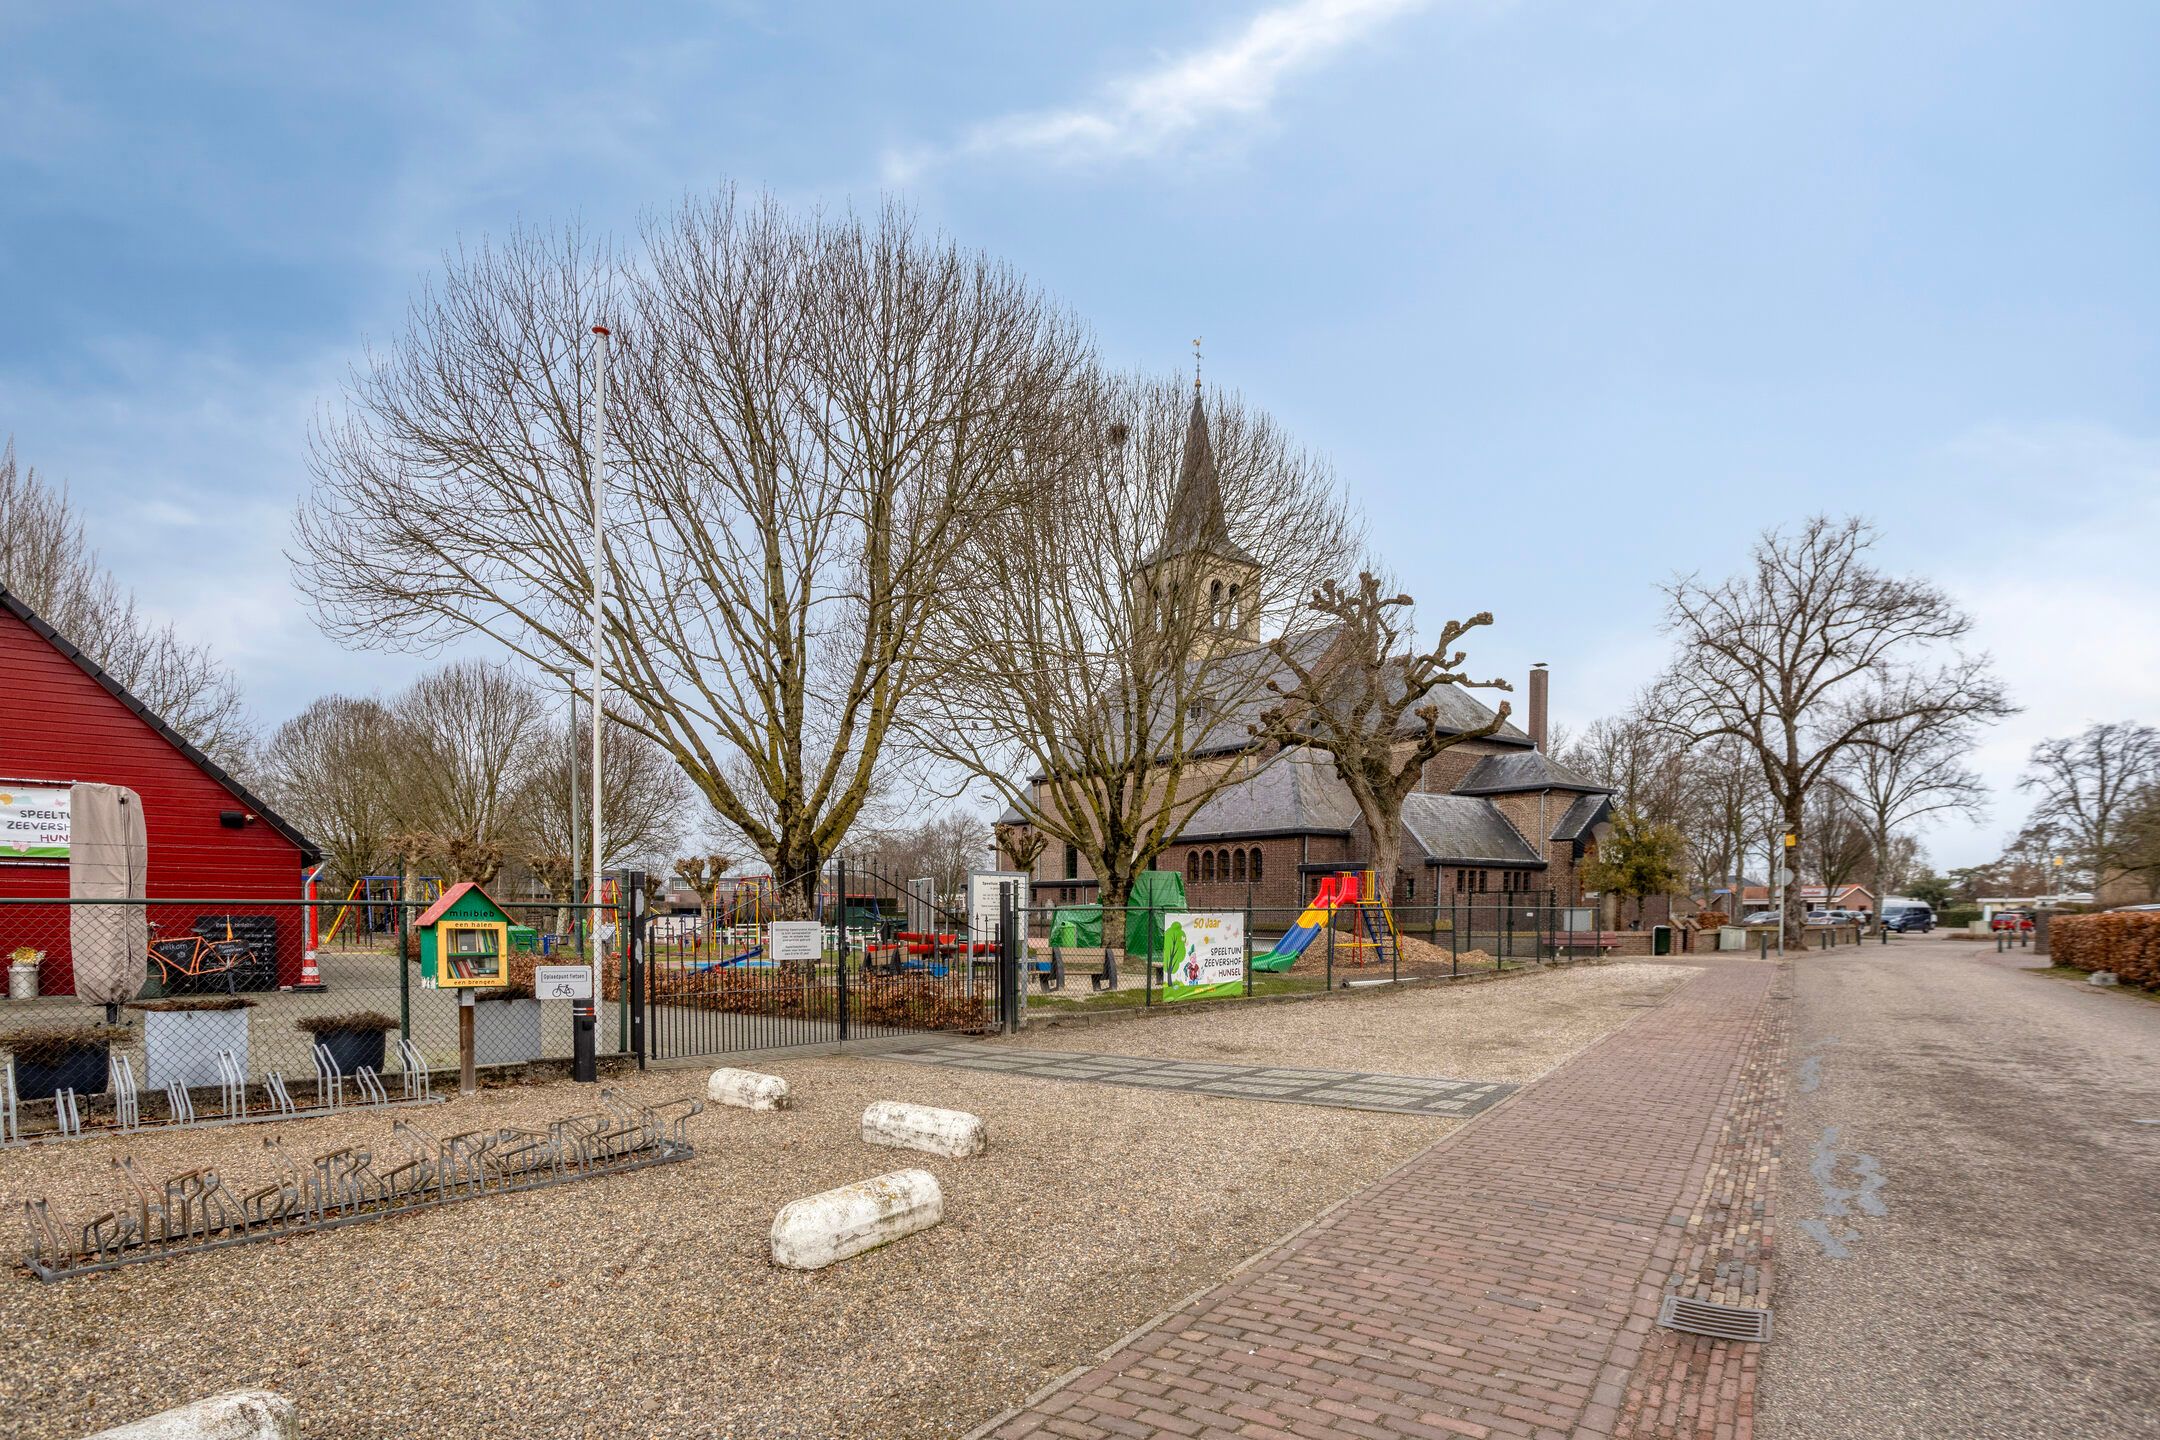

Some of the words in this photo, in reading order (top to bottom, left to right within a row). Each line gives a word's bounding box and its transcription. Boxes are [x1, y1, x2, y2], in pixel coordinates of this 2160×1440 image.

[1193, 917, 1204, 928] 50
[1205, 917, 1221, 928] Jaar
[1210, 946, 1242, 956] SPEELTUIN
[1204, 957, 1242, 967] ZEEVERSHOF
[1218, 968, 1241, 977] HUNSEL
